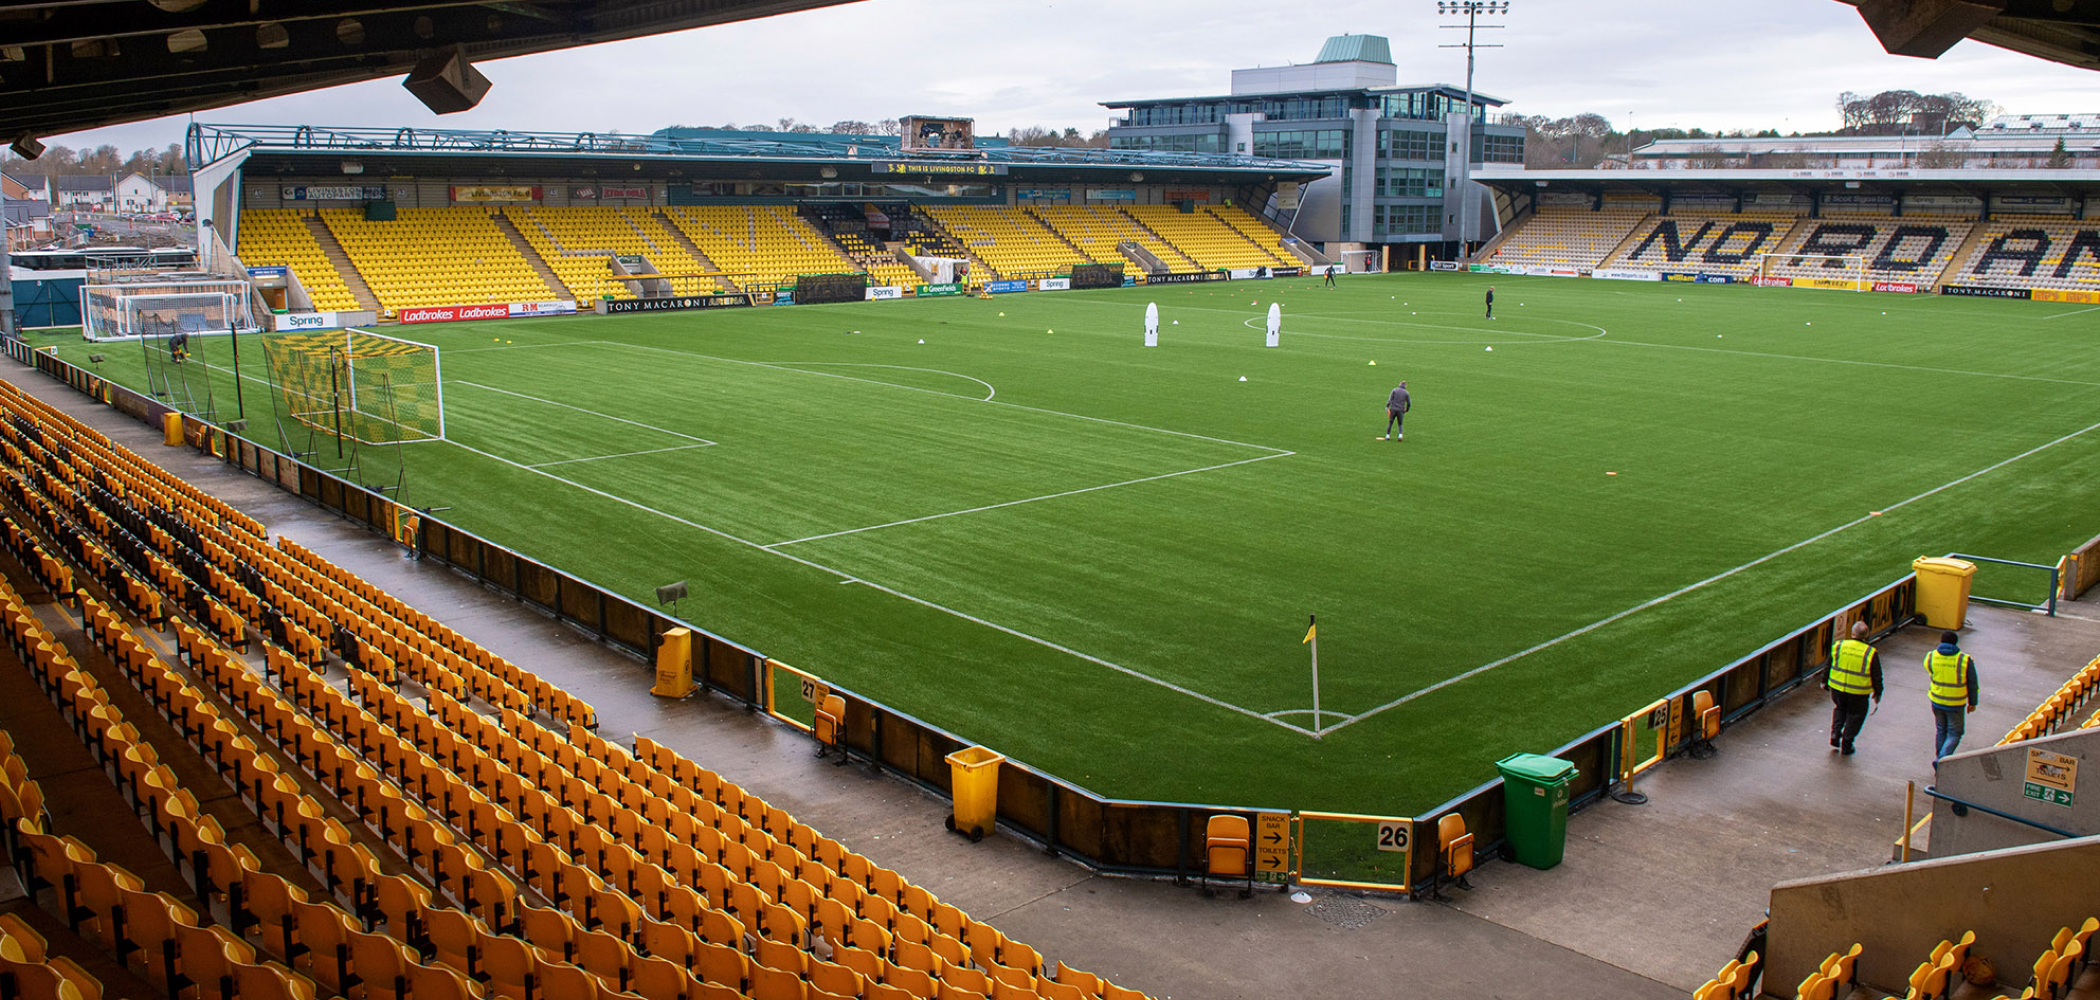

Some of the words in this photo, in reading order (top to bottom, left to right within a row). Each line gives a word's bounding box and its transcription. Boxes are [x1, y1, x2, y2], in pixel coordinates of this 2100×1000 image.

[929, 165, 966, 173] LIVINGSTON
[1167, 273, 1203, 282] MACARONI
[1753, 277, 1787, 287] Lbrokes
[1046, 280, 1064, 289] Spring
[872, 288, 894, 298] Spring
[1947, 287, 1971, 295] TONY
[1974, 289, 2026, 298] MACARONI
[608, 301, 639, 312] TONY
[643, 299, 706, 310] MACARONI
[708, 296, 746, 306] ARENA
[404, 308, 454, 322] Ladbrokes
[459, 305, 507, 318] Ladbrokes
[289, 316, 323, 327] Spring
[802, 680, 815, 699] 27
[1655, 706, 1667, 727] 25
[2060, 757, 2076, 766] BAR
[1262, 815, 1286, 823] SNACK
[1379, 826, 1408, 848] 26
[1259, 847, 1287, 855] TOILETS
